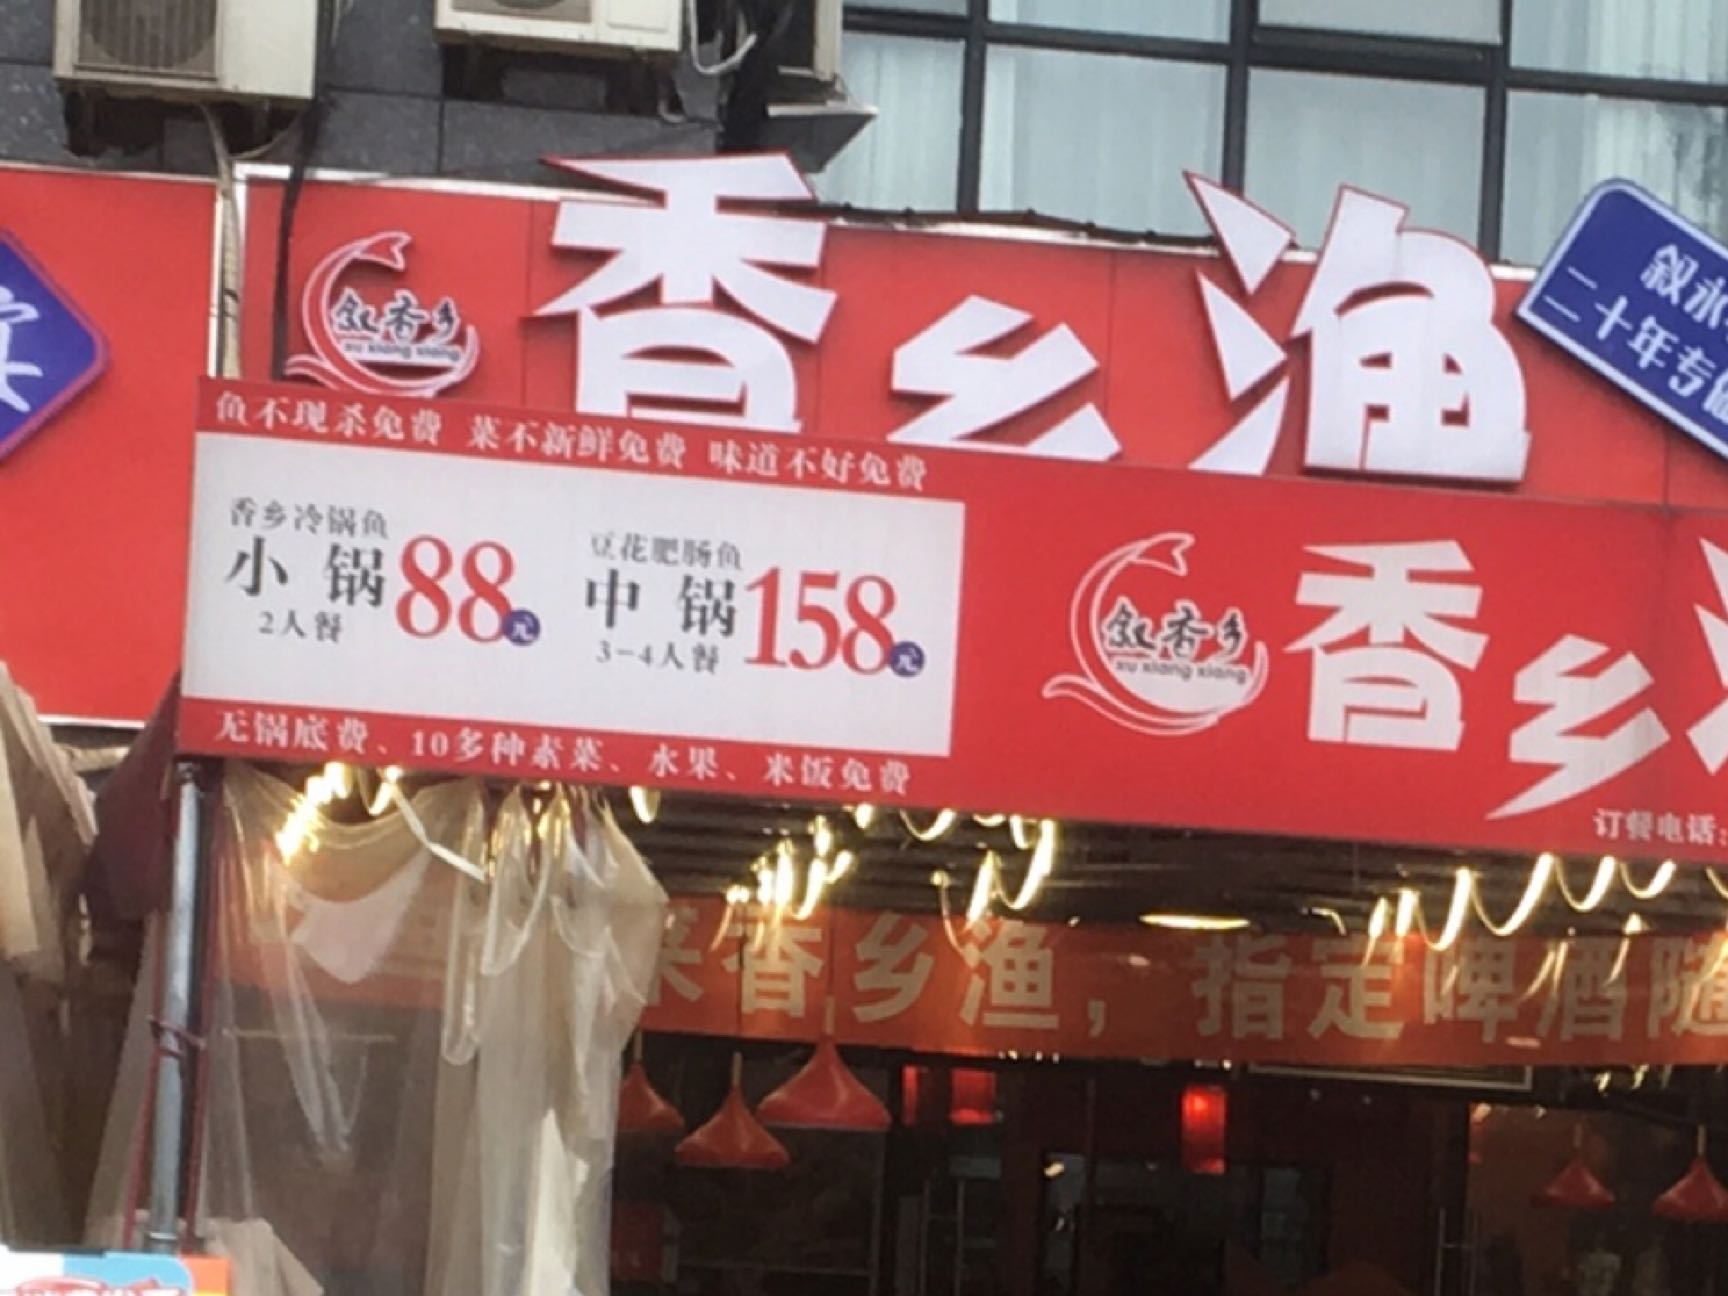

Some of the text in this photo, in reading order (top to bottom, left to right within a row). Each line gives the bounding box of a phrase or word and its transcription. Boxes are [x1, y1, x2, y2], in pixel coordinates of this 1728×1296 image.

[216, 390, 927, 491] 鱼不现杀免费 菜不新鲜免费 味道不好免费
[230, 496, 389, 539] 香乡冷锅鱼
[590, 531, 744, 570] 豆花肥肠鱼
[258, 608, 343, 644] 2人餐
